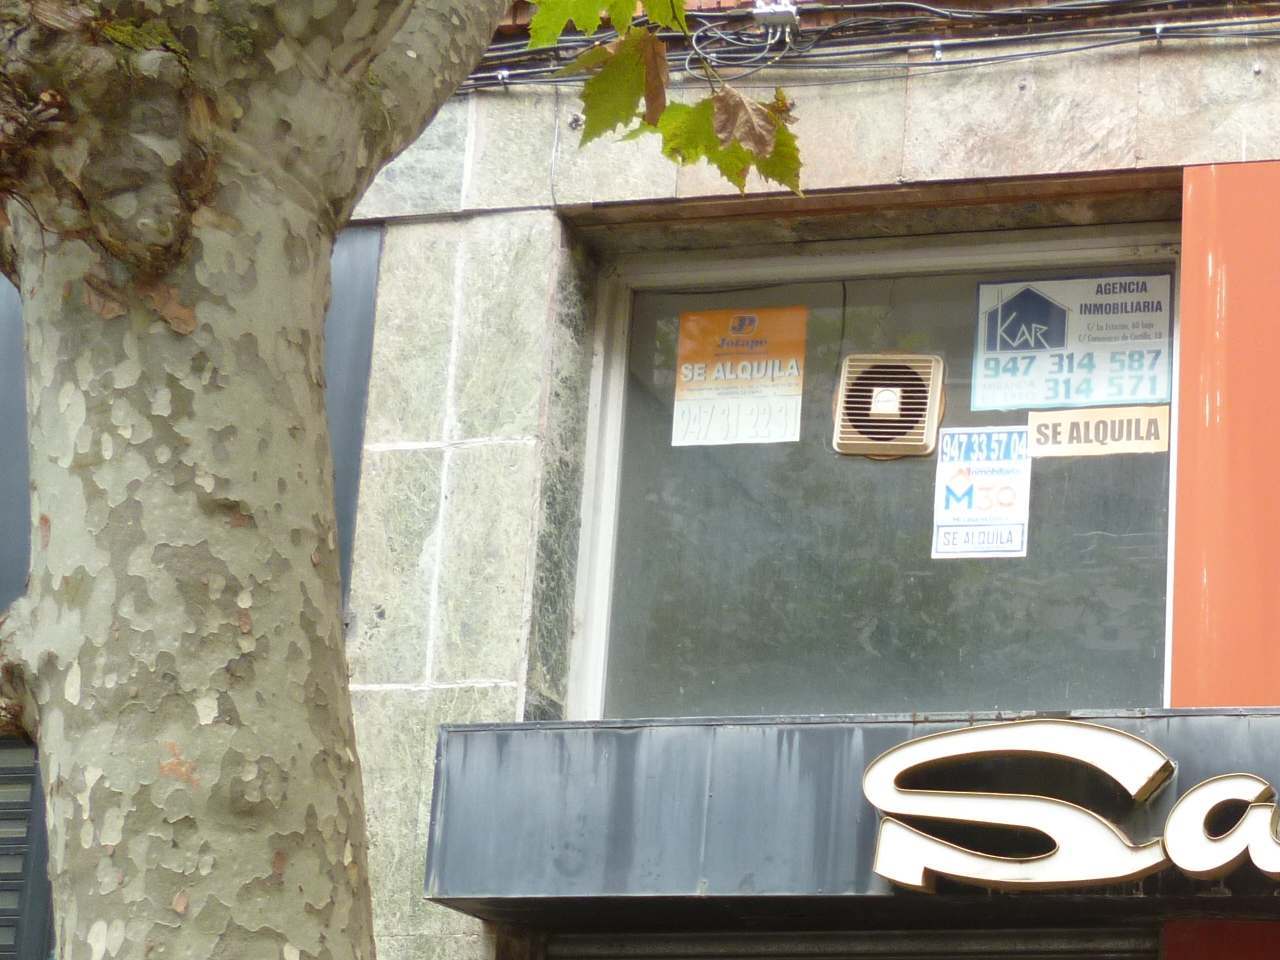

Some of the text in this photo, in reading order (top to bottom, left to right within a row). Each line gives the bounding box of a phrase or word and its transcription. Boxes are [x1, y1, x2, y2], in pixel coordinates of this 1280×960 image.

[1096, 281, 1147, 295] AGENCIA
[1080, 301, 1163, 315] INMOBILIARIA
[997, 311, 1050, 351] KAR
[681, 357, 800, 382] SE ALQUILA
[984, 350, 1162, 378] 947 314 587
[1045, 377, 1095, 400] 314
[1107, 375, 1158, 398] 571
[1036, 418, 1160, 446] SE ALQUILA
[943, 431, 1026, 462] 947 33 57 04
[943, 531, 959, 547] SE
